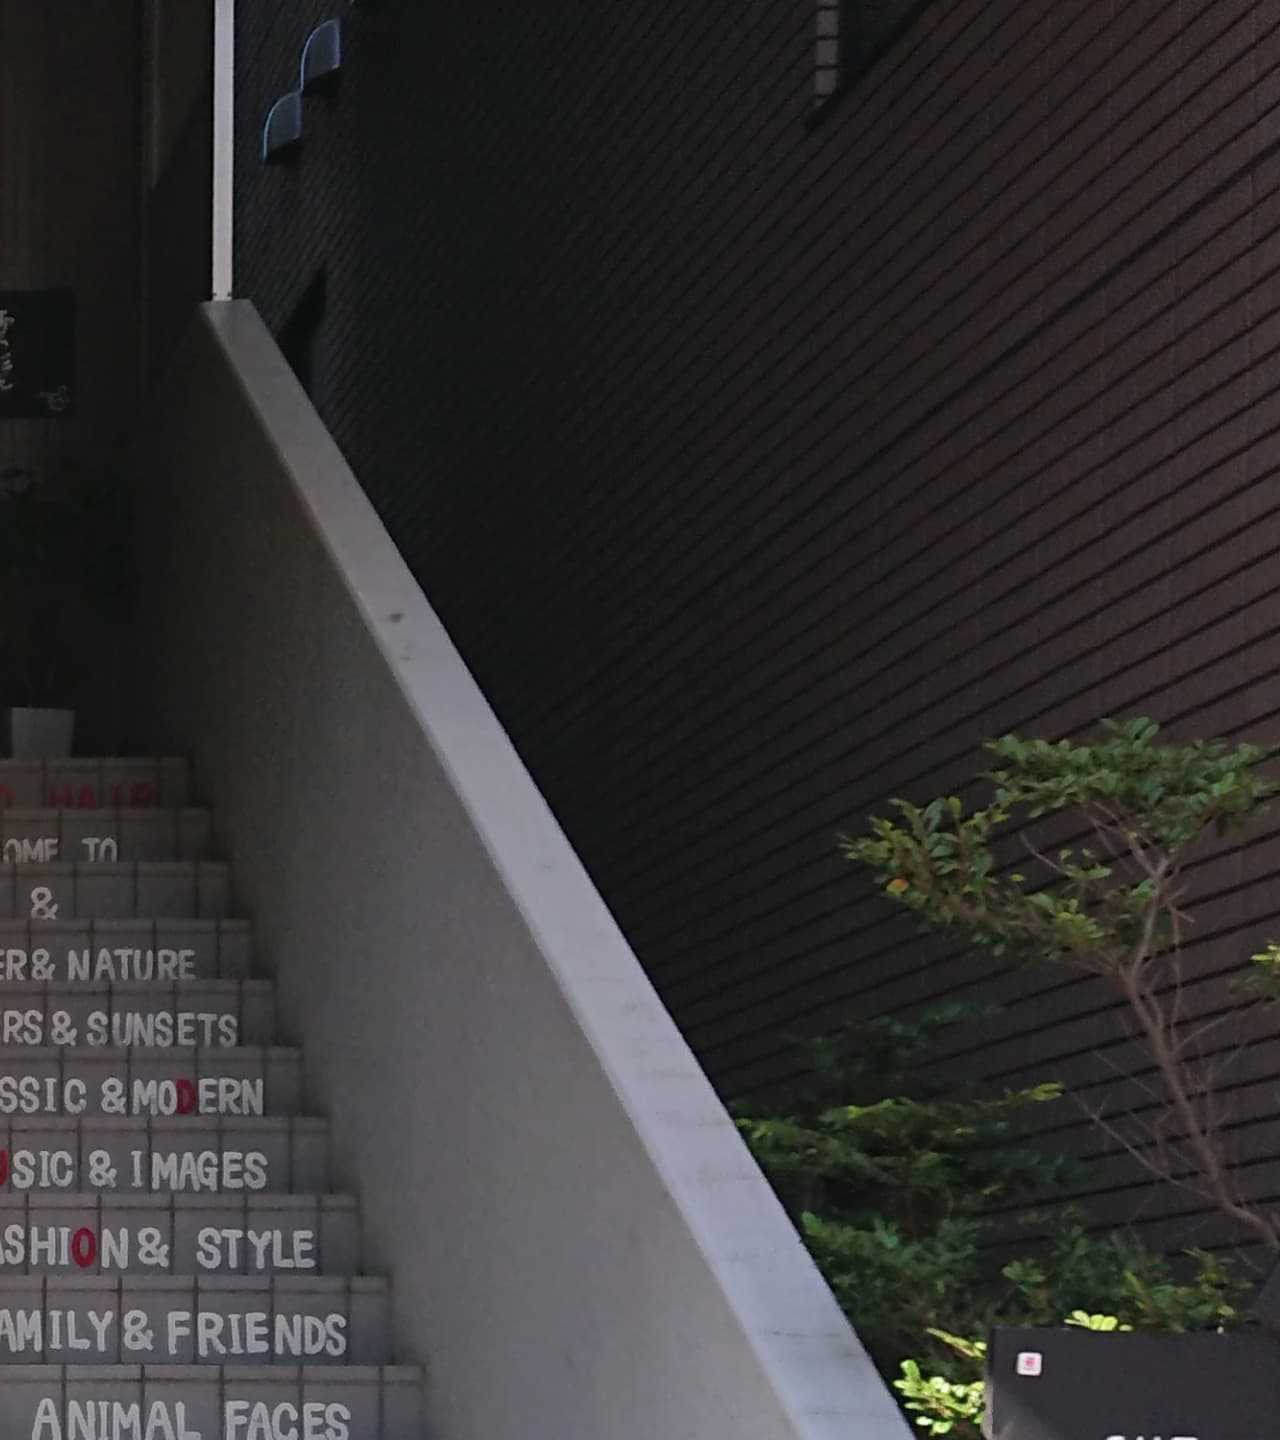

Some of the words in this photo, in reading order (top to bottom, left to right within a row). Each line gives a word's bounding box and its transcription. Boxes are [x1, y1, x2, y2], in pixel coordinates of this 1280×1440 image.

[30, 886, 58, 920] &
[30, 949, 55, 981] &
[68, 948, 196, 981] NATURE
[51, 1010, 77, 1046] &
[86, 1011, 239, 1048] SUNSETS
[101, 1077, 127, 1115] &
[131, 1078, 264, 1115] MODERN
[88, 1150, 118, 1189] &
[132, 1150, 268, 1192] IMAGES
[138, 1227, 170, 1268] &
[196, 1226, 317, 1270] STYLE
[123, 1310, 154, 1352] &
[167, 1311, 347, 1357] FRIENDS
